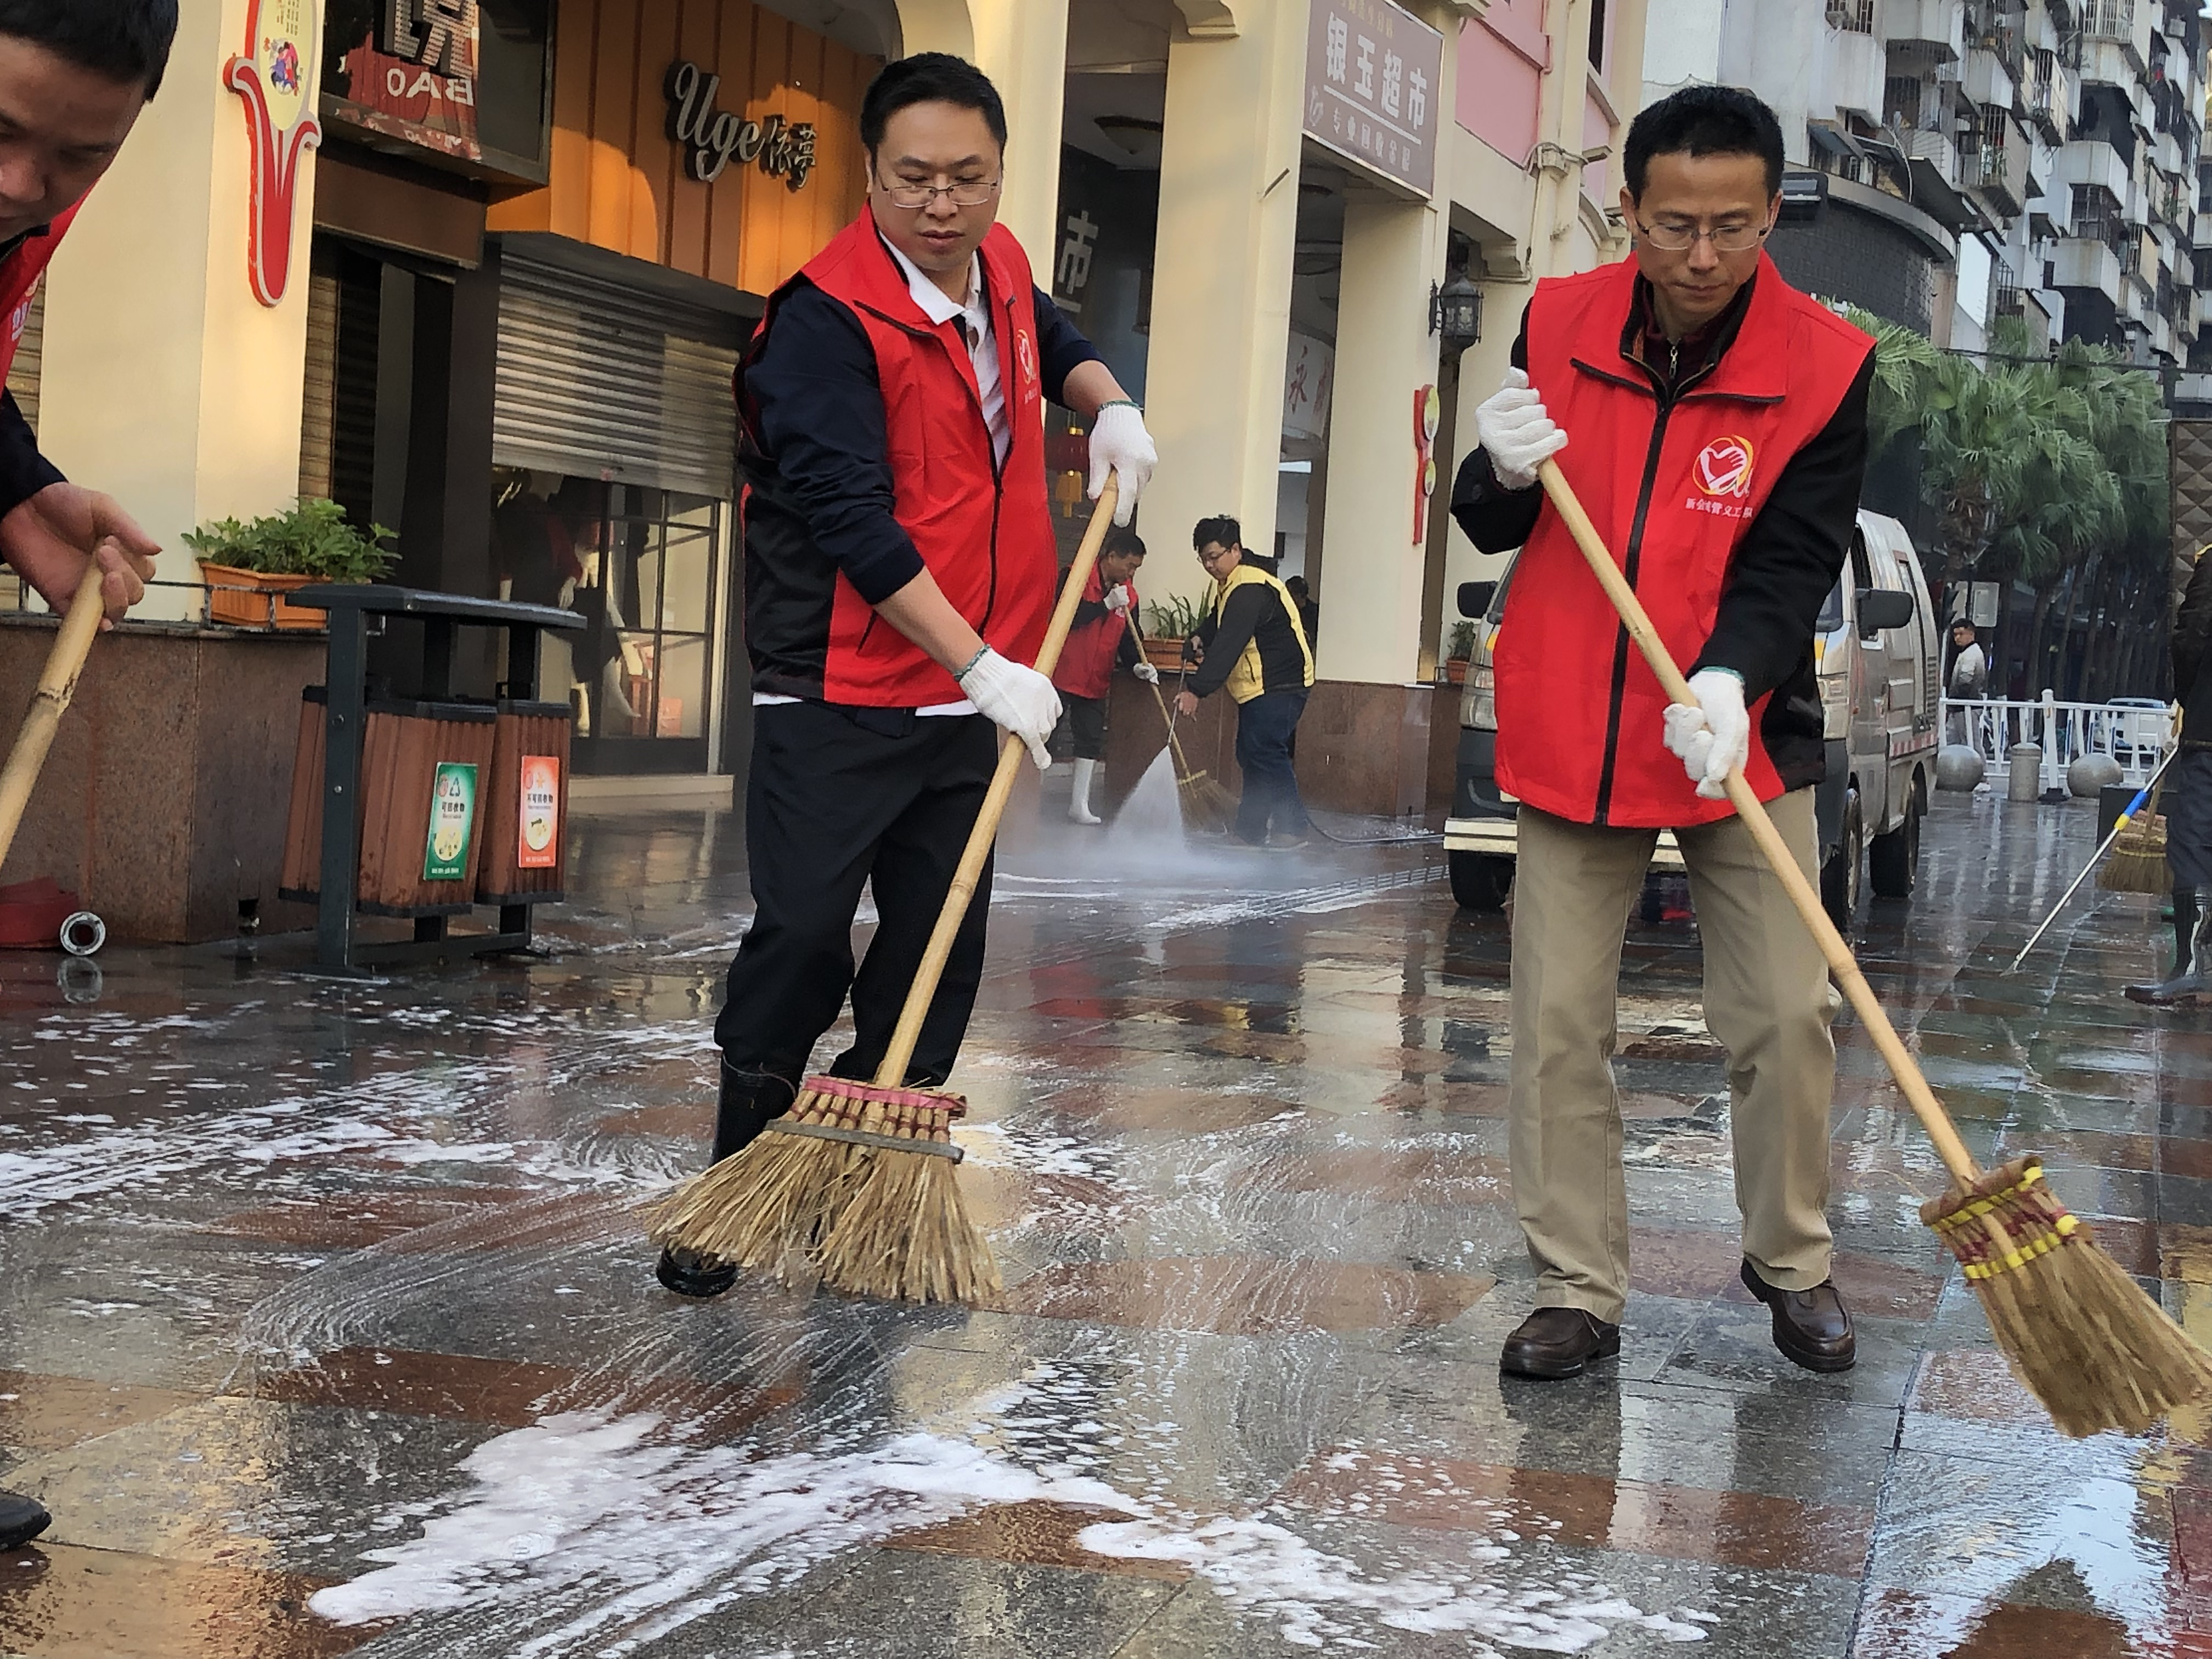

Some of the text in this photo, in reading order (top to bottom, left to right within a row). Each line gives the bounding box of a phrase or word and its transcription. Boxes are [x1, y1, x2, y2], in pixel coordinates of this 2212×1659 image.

[674, 62, 766, 183] Uge
[1326, 12, 1427, 131] 银玉超市
[1057, 210, 1099, 295] 市
